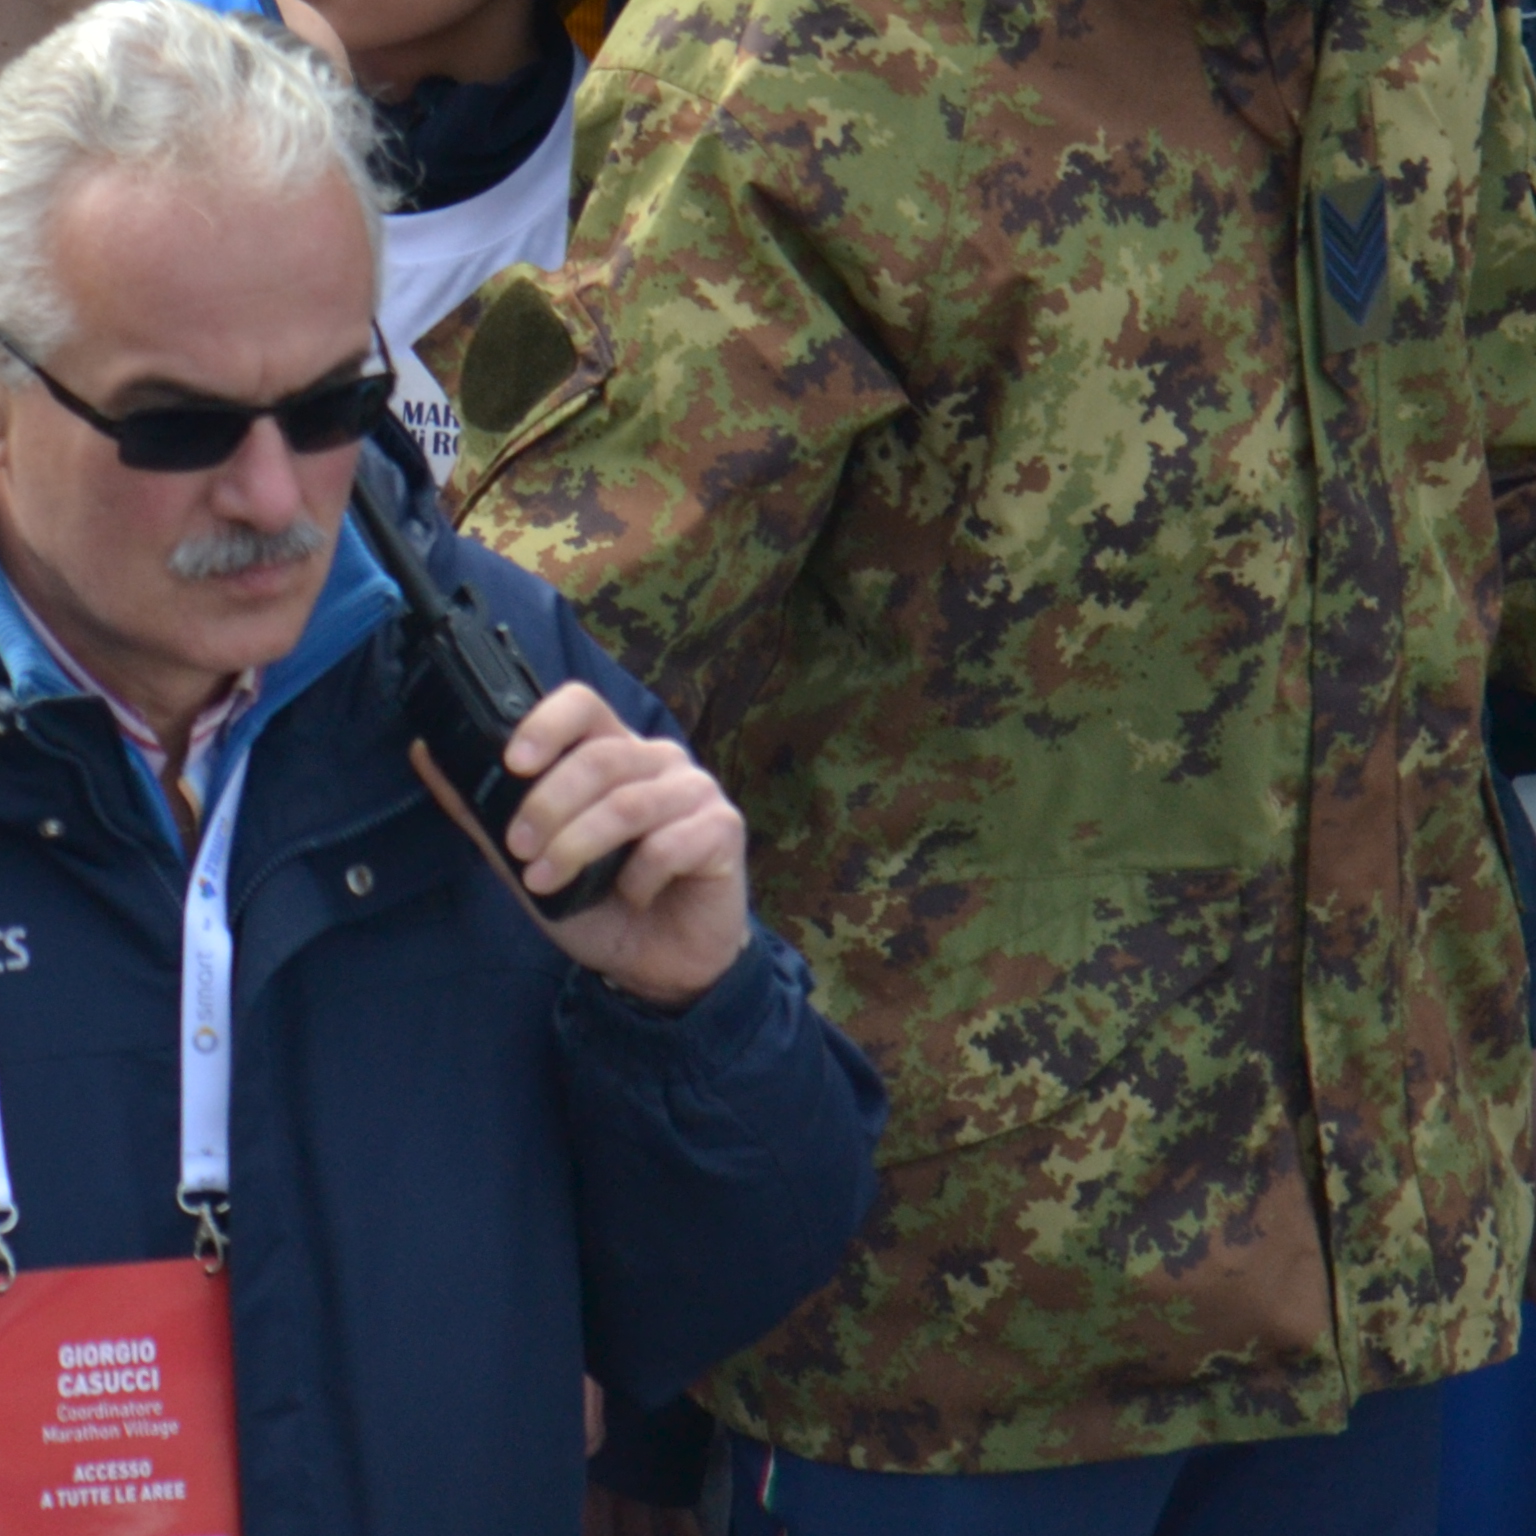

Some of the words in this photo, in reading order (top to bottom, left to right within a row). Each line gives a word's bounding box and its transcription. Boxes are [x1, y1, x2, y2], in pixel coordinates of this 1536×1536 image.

[58, 1337, 158, 1370] GIORGIO
[57, 1365, 161, 1399] CASUCCI
[55, 1399, 164, 1424] Coordinatore
[41, 1423, 122, 1445] Marathon
[123, 1417, 181, 1441] Village
[73, 1458, 153, 1482] ACCESSO
[39, 1488, 55, 1510] A
[55, 1485, 113, 1508] TUTTE
[114, 1482, 137, 1504] LE
[139, 1477, 187, 1501] AREE
